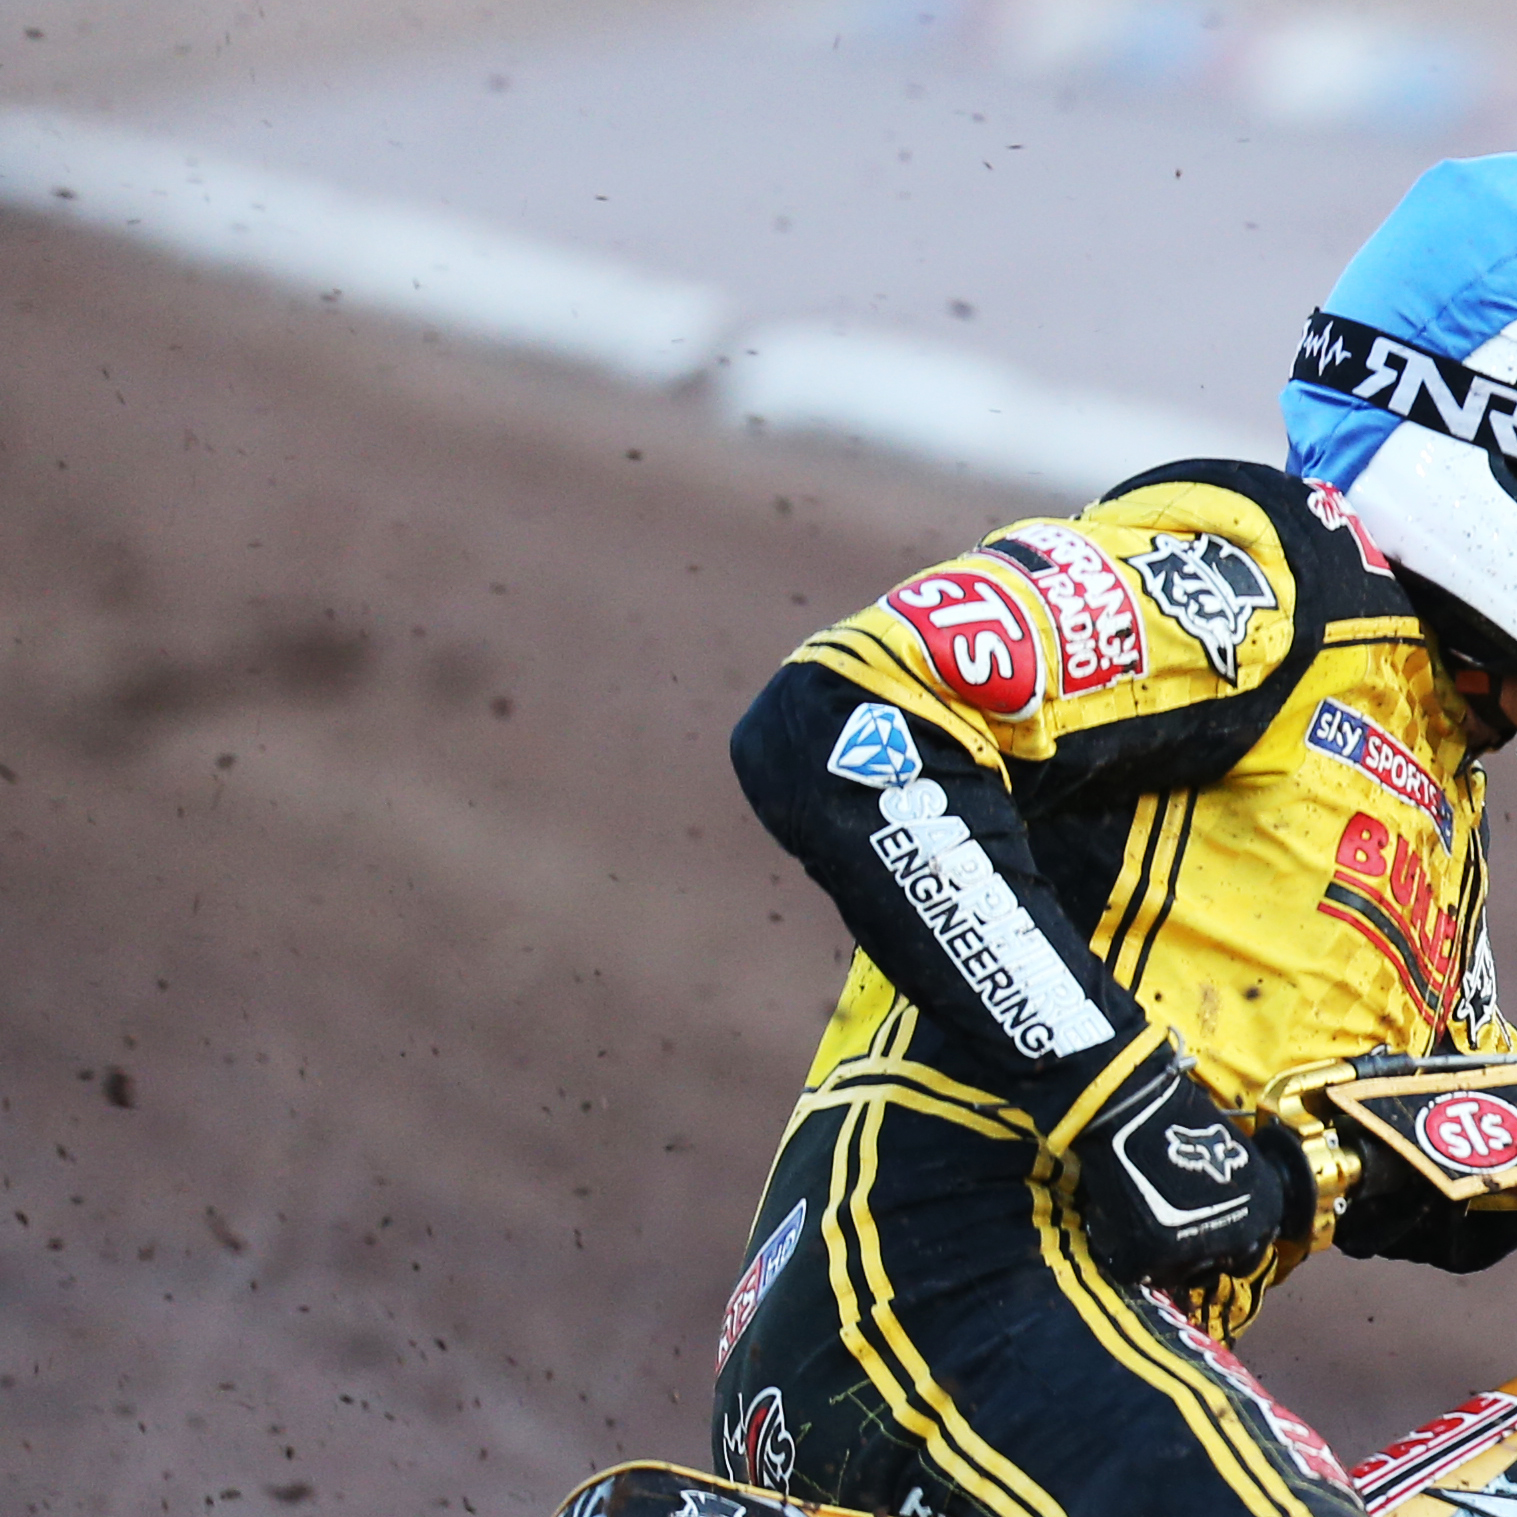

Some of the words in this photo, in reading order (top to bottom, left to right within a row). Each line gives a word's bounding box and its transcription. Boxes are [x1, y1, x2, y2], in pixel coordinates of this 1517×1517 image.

[898, 578, 1024, 685] STS
[1038, 572, 1098, 679] RADIO
[1317, 710, 1363, 757] sky
[876, 827, 1055, 1054] ENGINEERING
[880, 778, 1116, 1057] SAPPHIRE
[1439, 1101, 1513, 1159] STS
